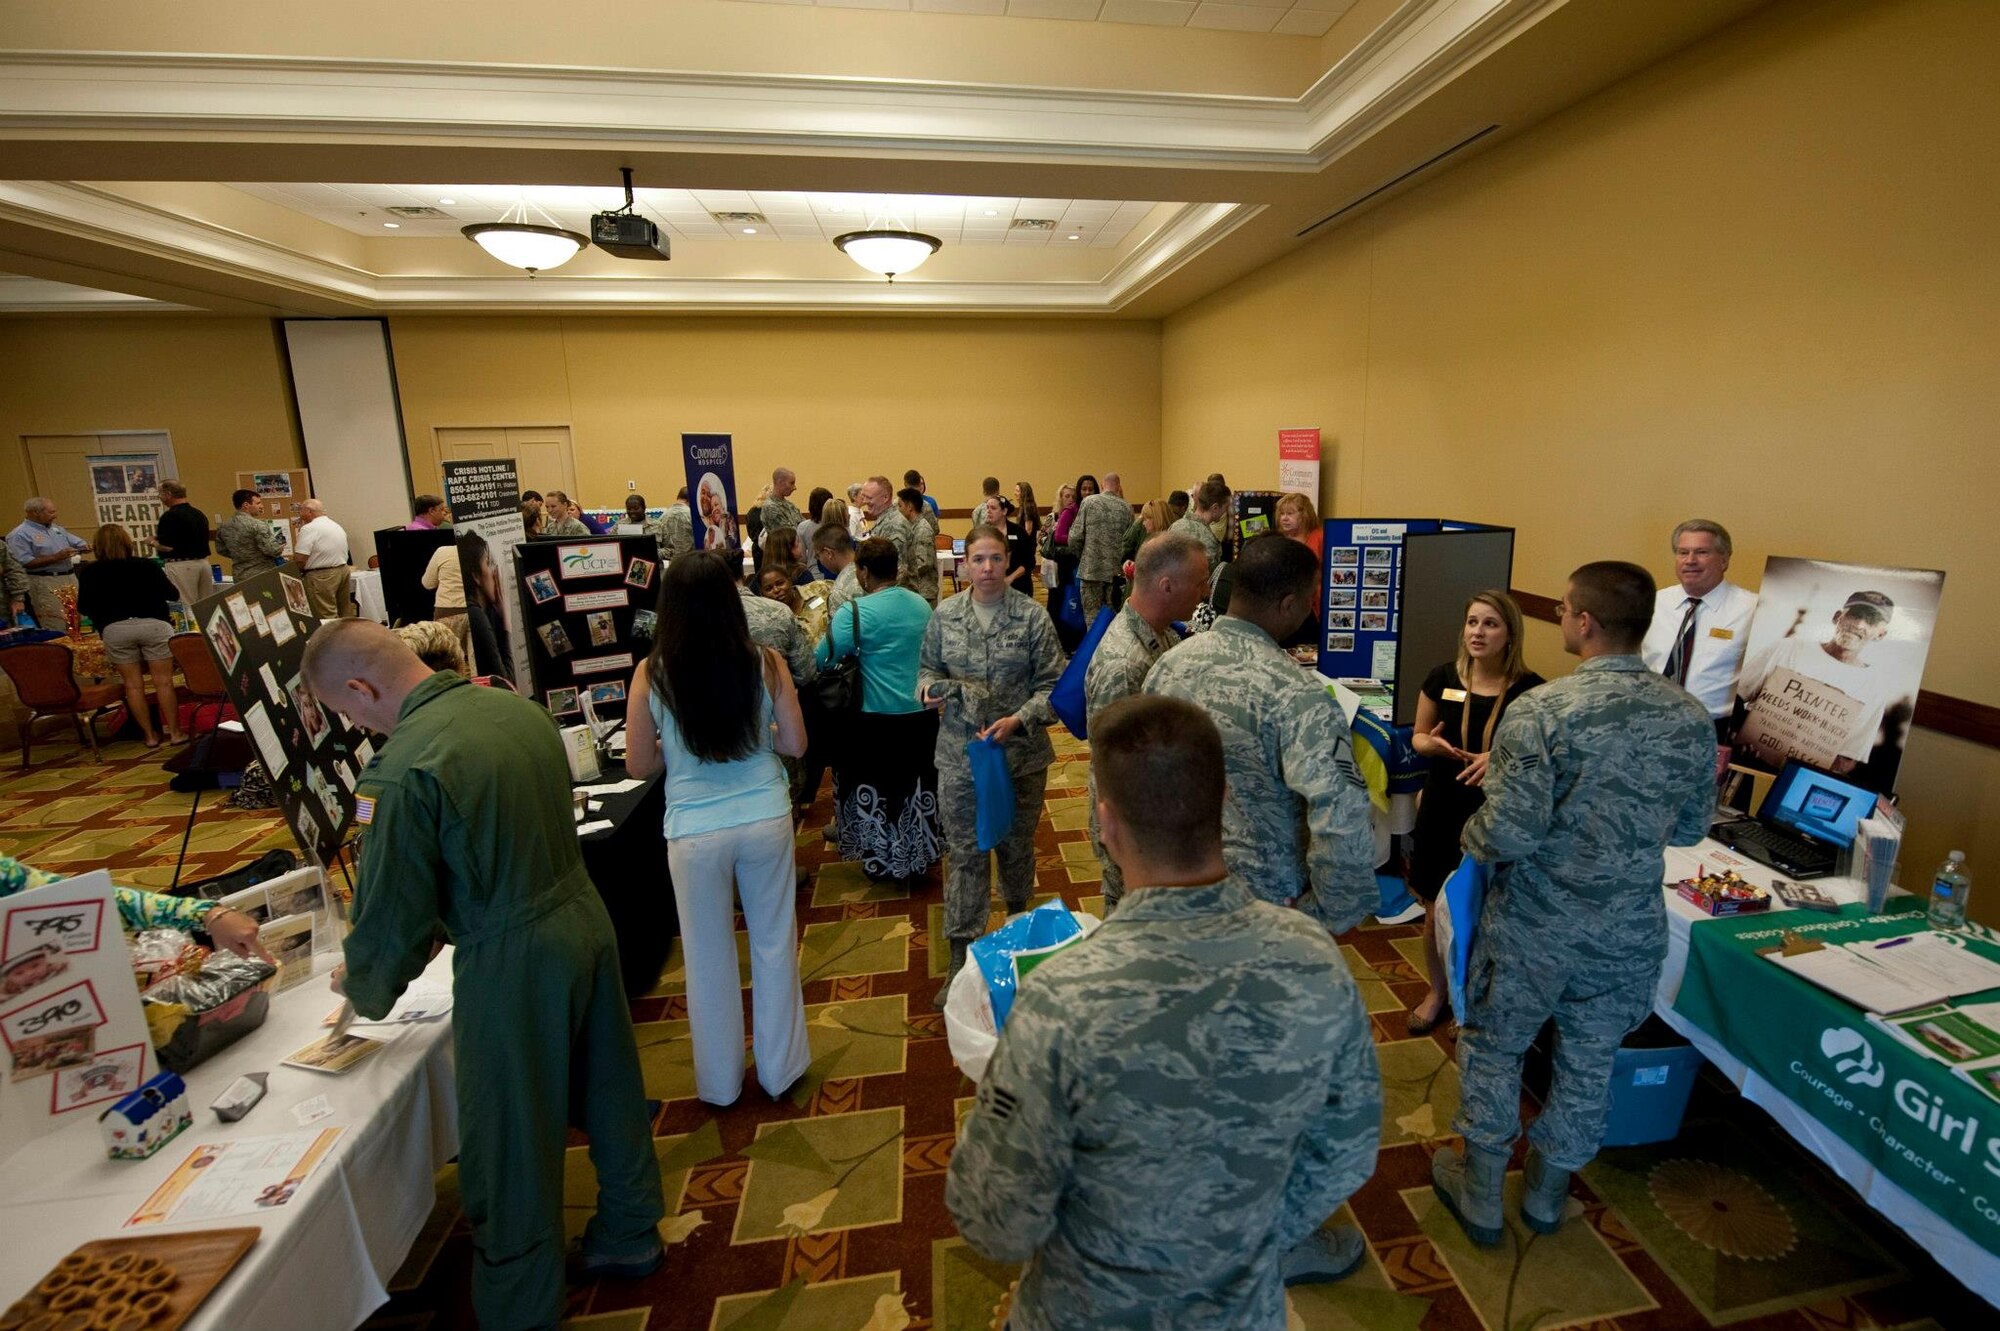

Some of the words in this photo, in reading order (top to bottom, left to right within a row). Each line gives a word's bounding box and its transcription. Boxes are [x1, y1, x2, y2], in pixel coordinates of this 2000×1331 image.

[454, 467, 477, 475] CRISIS
[479, 465, 506, 473] HOTLINE
[448, 476, 467, 485] RAPE
[469, 474, 491, 482] CRISIS
[492, 472, 516, 480] CENTER
[450, 482, 496, 494] 850-244-9191
[452, 491, 497, 504] 850-682-0101
[476, 501, 488, 509] 711
[99, 504, 161, 522] HEART
[581, 559, 606, 570] UCP
[1760, 691, 1791, 711] NEEDS
[1783, 679, 1848, 720] PAINTER
[1759, 733, 1783, 751] GOD
[1790, 1060, 1853, 1111] Courage
[1869, 1116, 1956, 1185] Character
[1894, 1078, 1979, 1155] Girl
